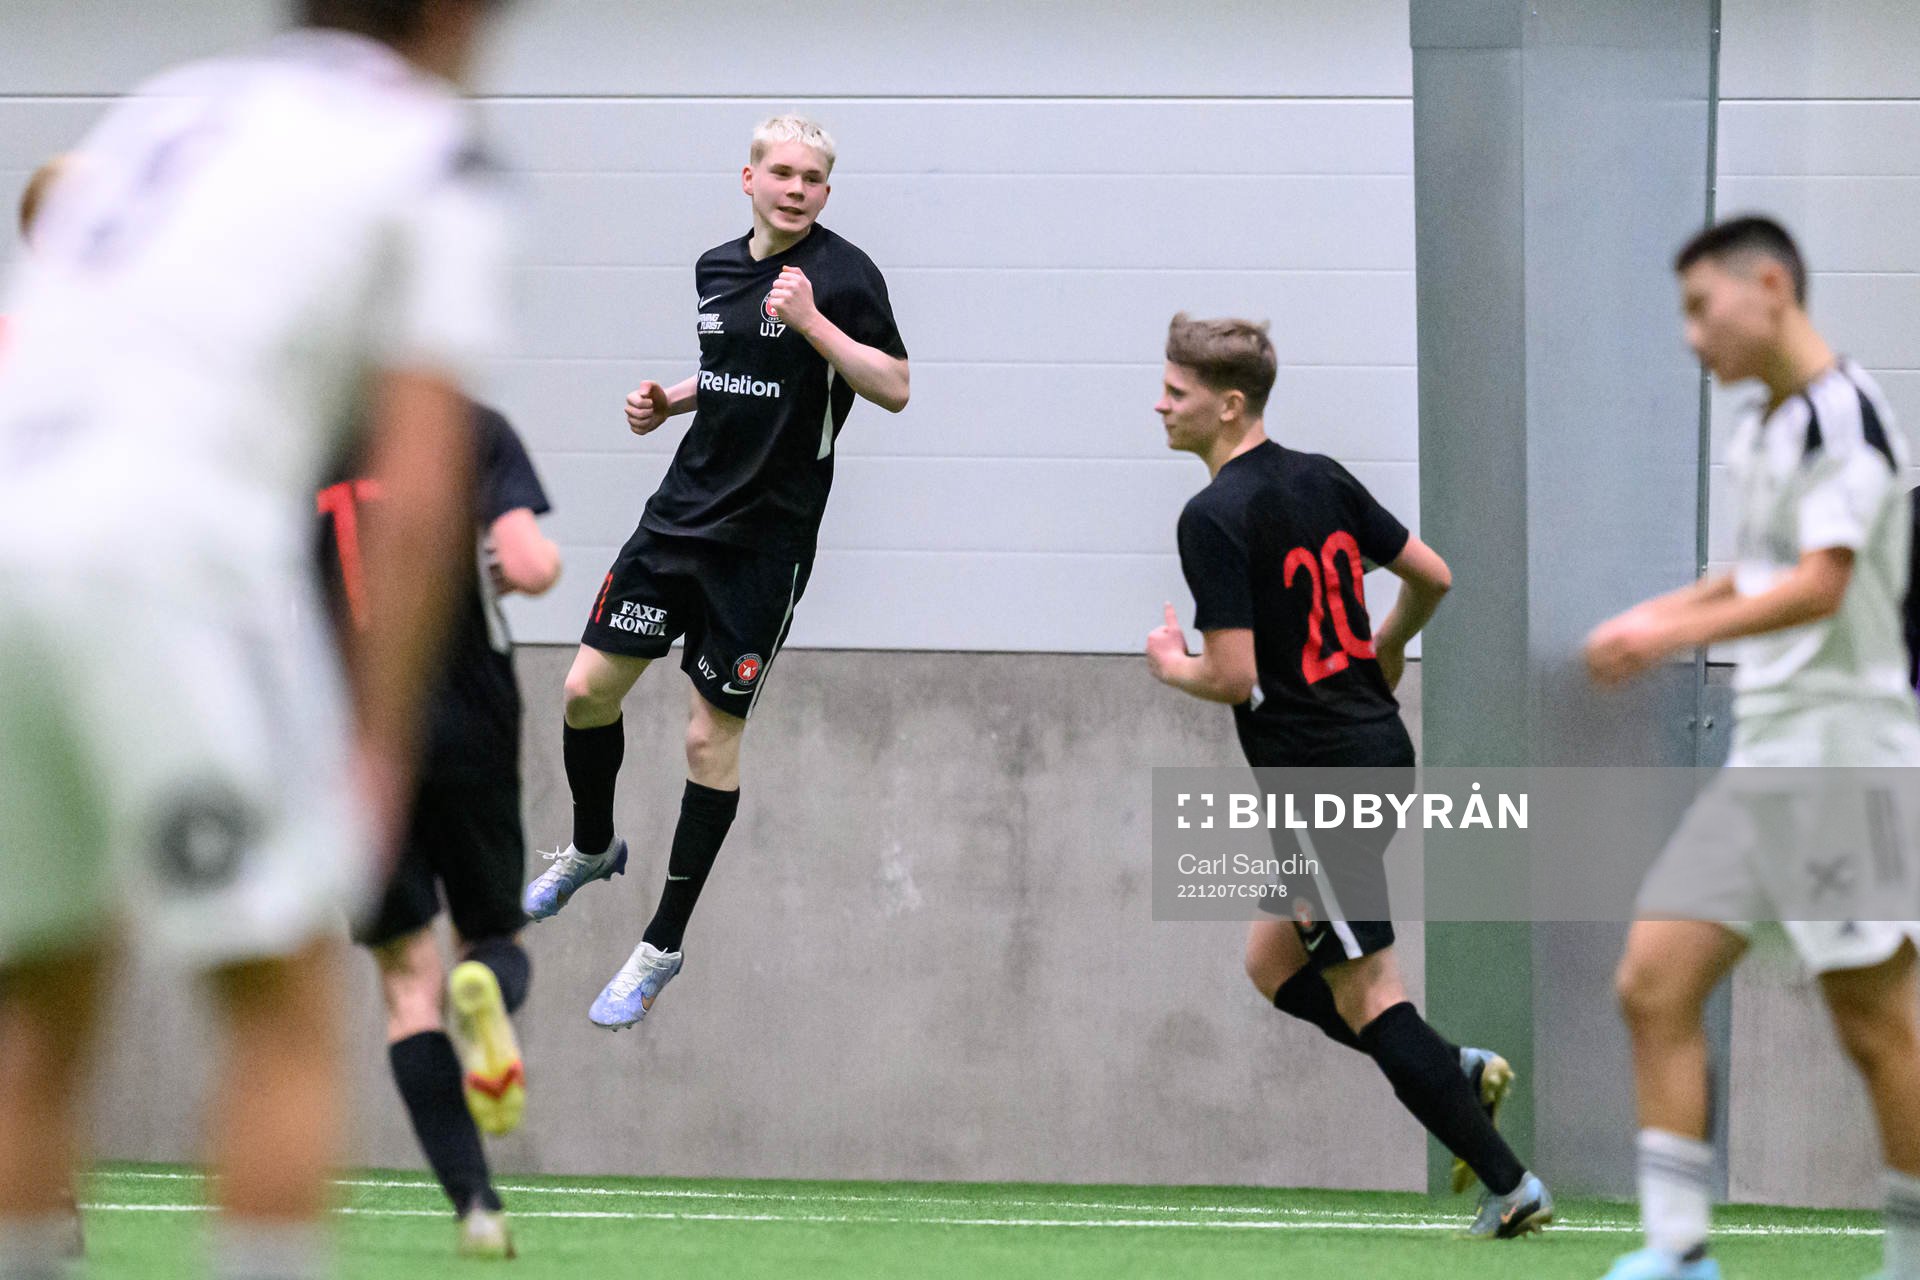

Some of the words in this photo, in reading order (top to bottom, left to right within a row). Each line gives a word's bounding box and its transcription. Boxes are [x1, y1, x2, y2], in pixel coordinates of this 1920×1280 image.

[760, 322, 786, 338] U17
[699, 370, 780, 398] Relation
[620, 600, 668, 623] FAXE
[1283, 530, 1377, 685] 20
[608, 613, 668, 636] KONDI
[697, 656, 718, 681] U17
